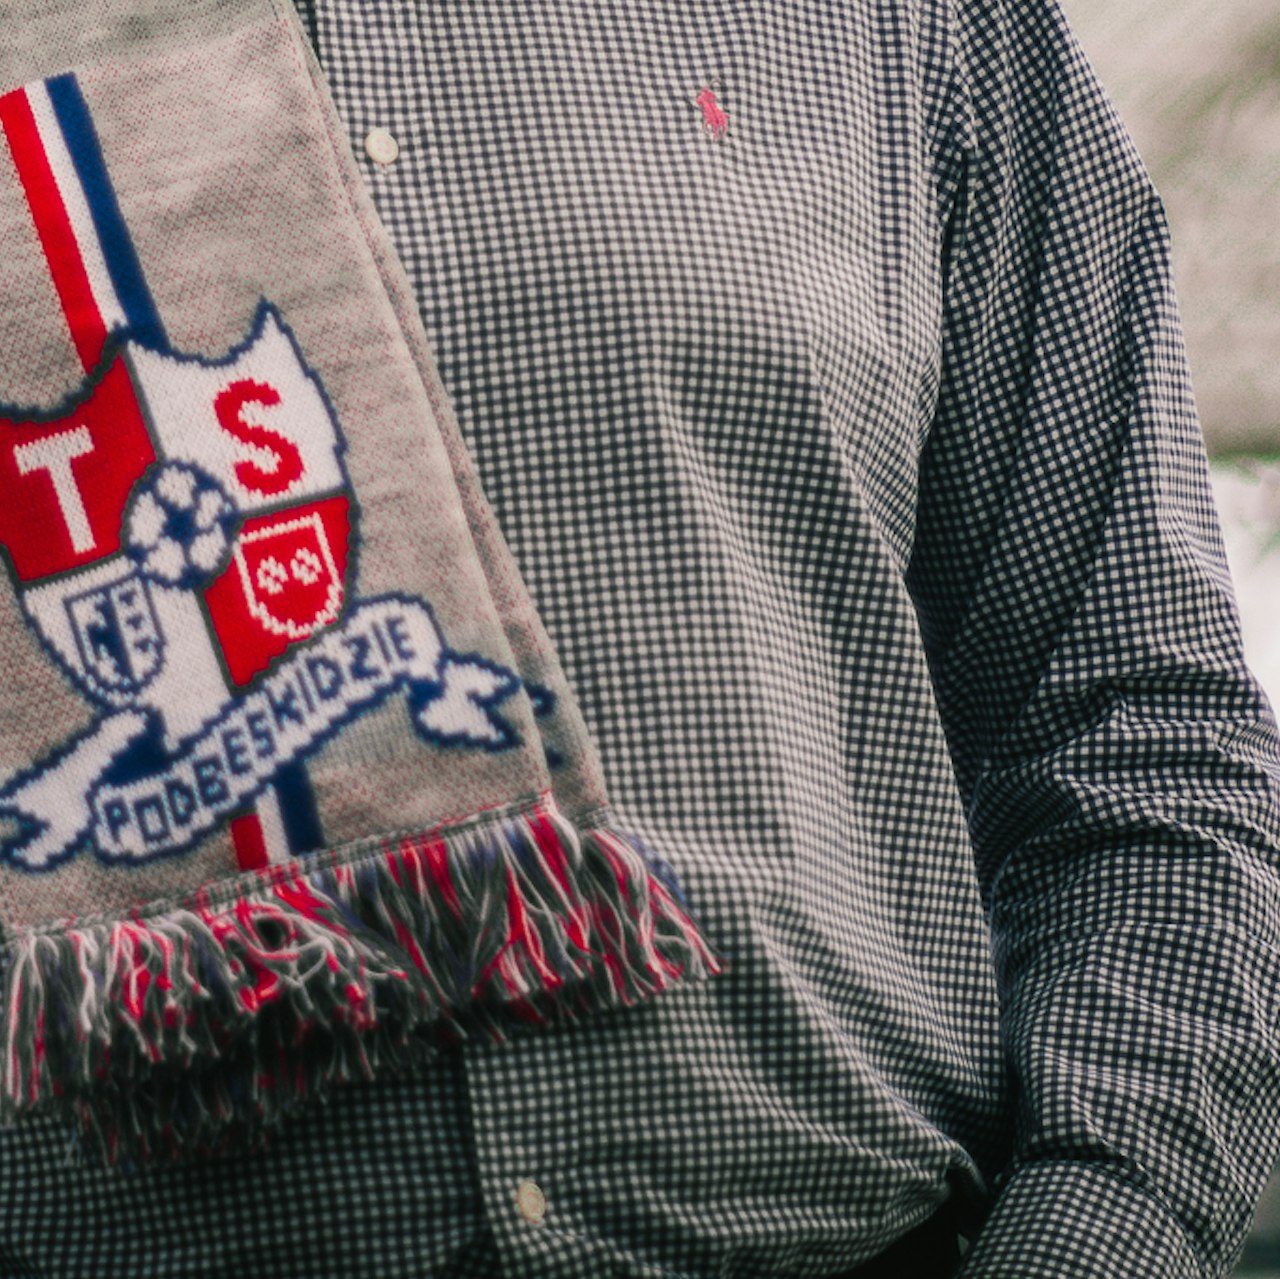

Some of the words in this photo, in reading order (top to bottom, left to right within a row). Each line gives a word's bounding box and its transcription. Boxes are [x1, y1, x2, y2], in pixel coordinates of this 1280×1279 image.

[13, 424, 96, 555] T
[213, 377, 304, 498] S
[100, 616, 415, 844] PODBESKIDZIE
